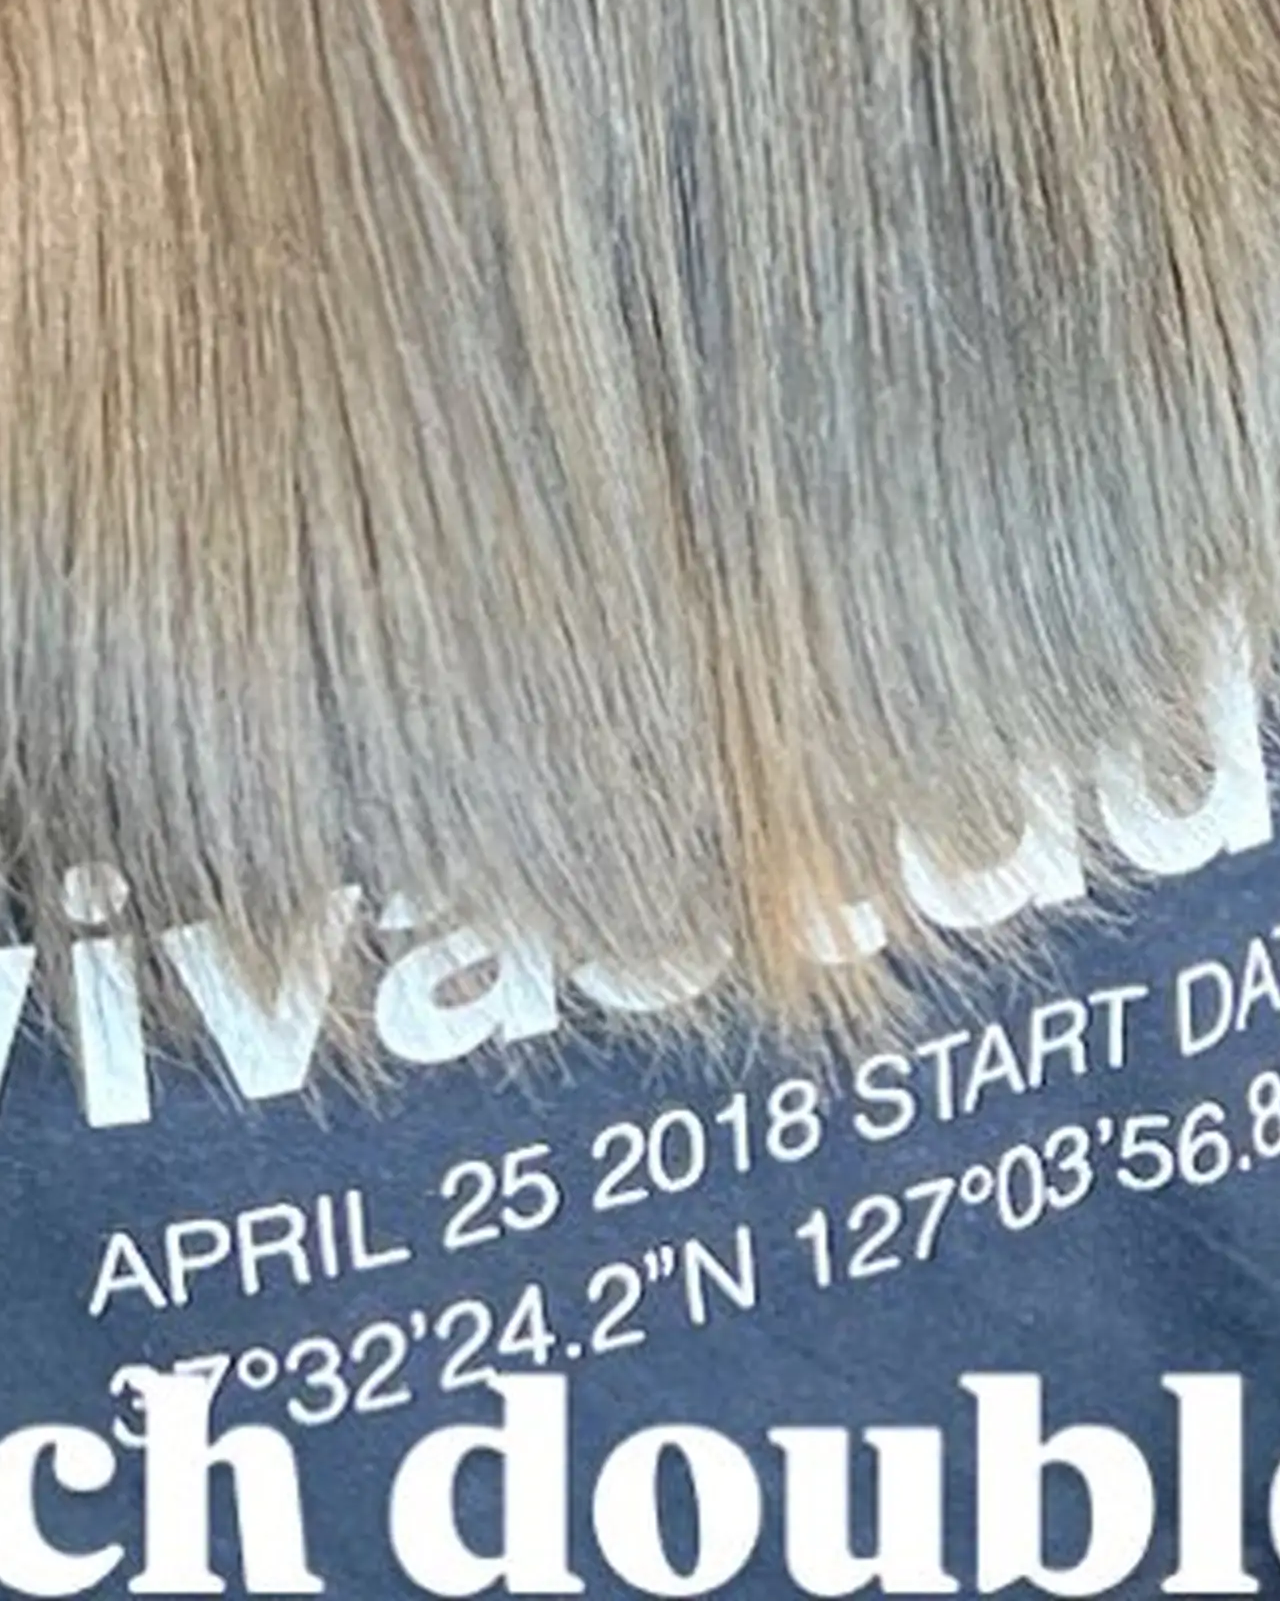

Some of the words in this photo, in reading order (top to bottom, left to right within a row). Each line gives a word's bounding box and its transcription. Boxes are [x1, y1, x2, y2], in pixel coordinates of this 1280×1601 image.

[88, 1190, 410, 1316] APRIL
[440, 1144, 561, 1249] 25
[591, 1078, 822, 1211] 2018
[853, 983, 1148, 1141] START
